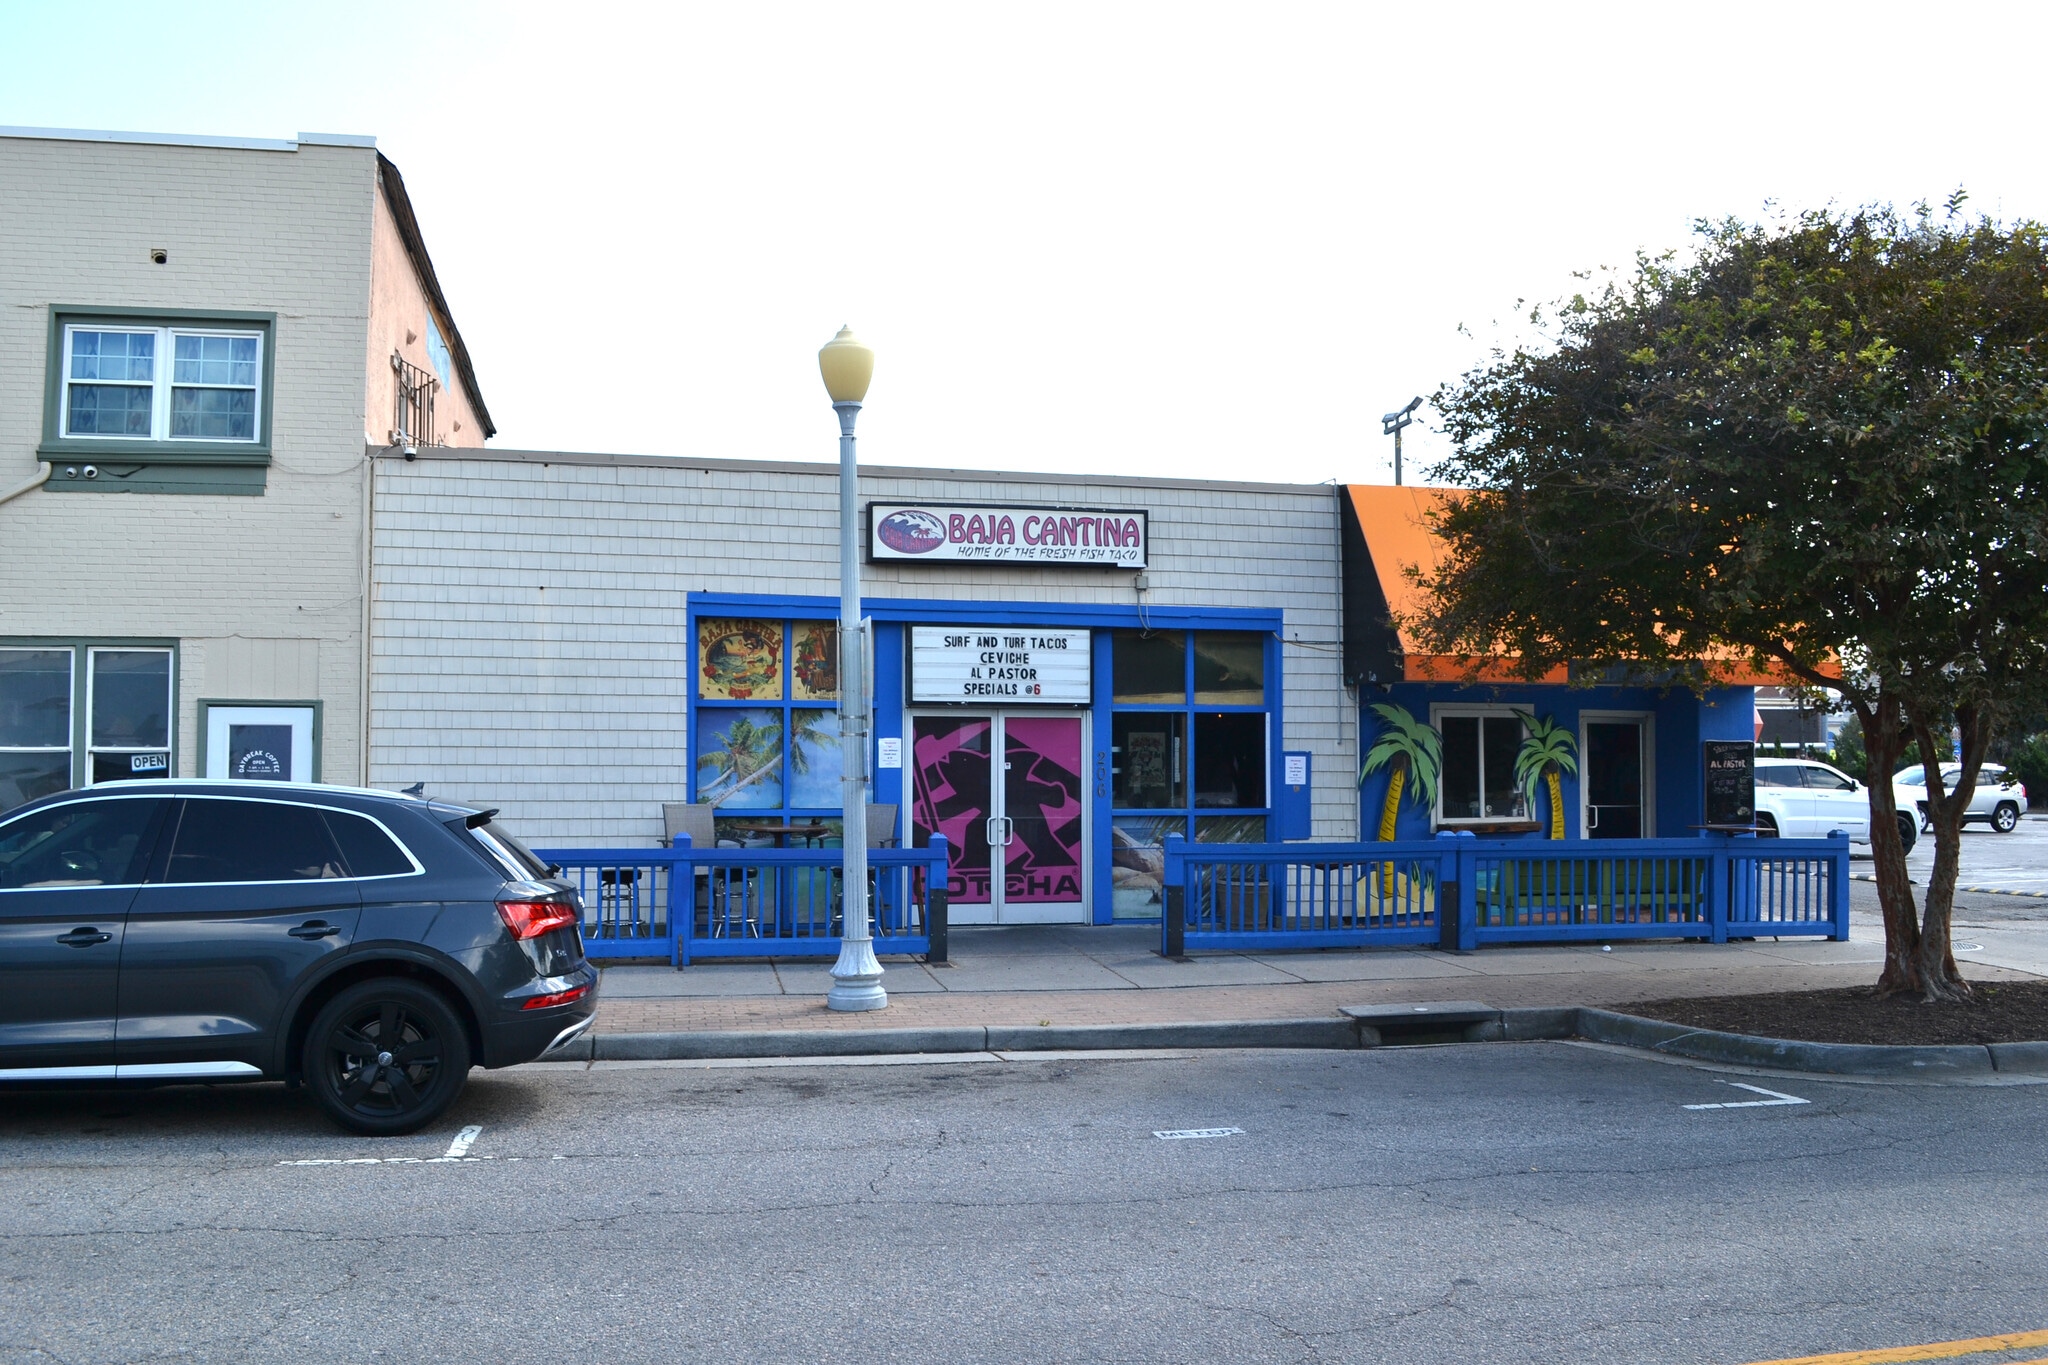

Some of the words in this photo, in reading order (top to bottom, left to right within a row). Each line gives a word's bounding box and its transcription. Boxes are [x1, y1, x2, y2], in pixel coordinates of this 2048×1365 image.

[949, 513, 1016, 546] BAJA
[1022, 515, 1141, 548] CANTINA
[957, 546, 991, 558] HOME
[994, 547, 1011, 558] OF
[1014, 547, 1036, 559] THE
[1039, 548, 1076, 560] FRESH
[1079, 549, 1105, 560] FISH
[1109, 549, 1138, 561] TACO
[699, 619, 732, 649] BAJA
[944, 635, 971, 648] SURF
[976, 636, 998, 648] AND
[1003, 636, 1026, 649] TURF
[1030, 637, 1068, 650] TACOS
[980, 651, 1030, 665] CEVICHE
[971, 667, 982, 679] AL
[988, 667, 1037, 680] PASTOR
[963, 682, 1018, 696] SPECIALS
[133, 755, 165, 768] OPEN
[238, 750, 264, 773] DAYBREAK
[265, 752, 280, 773] COFFEE
[1710, 760, 1722, 769] AL
[1097, 751, 1106, 799] 206
